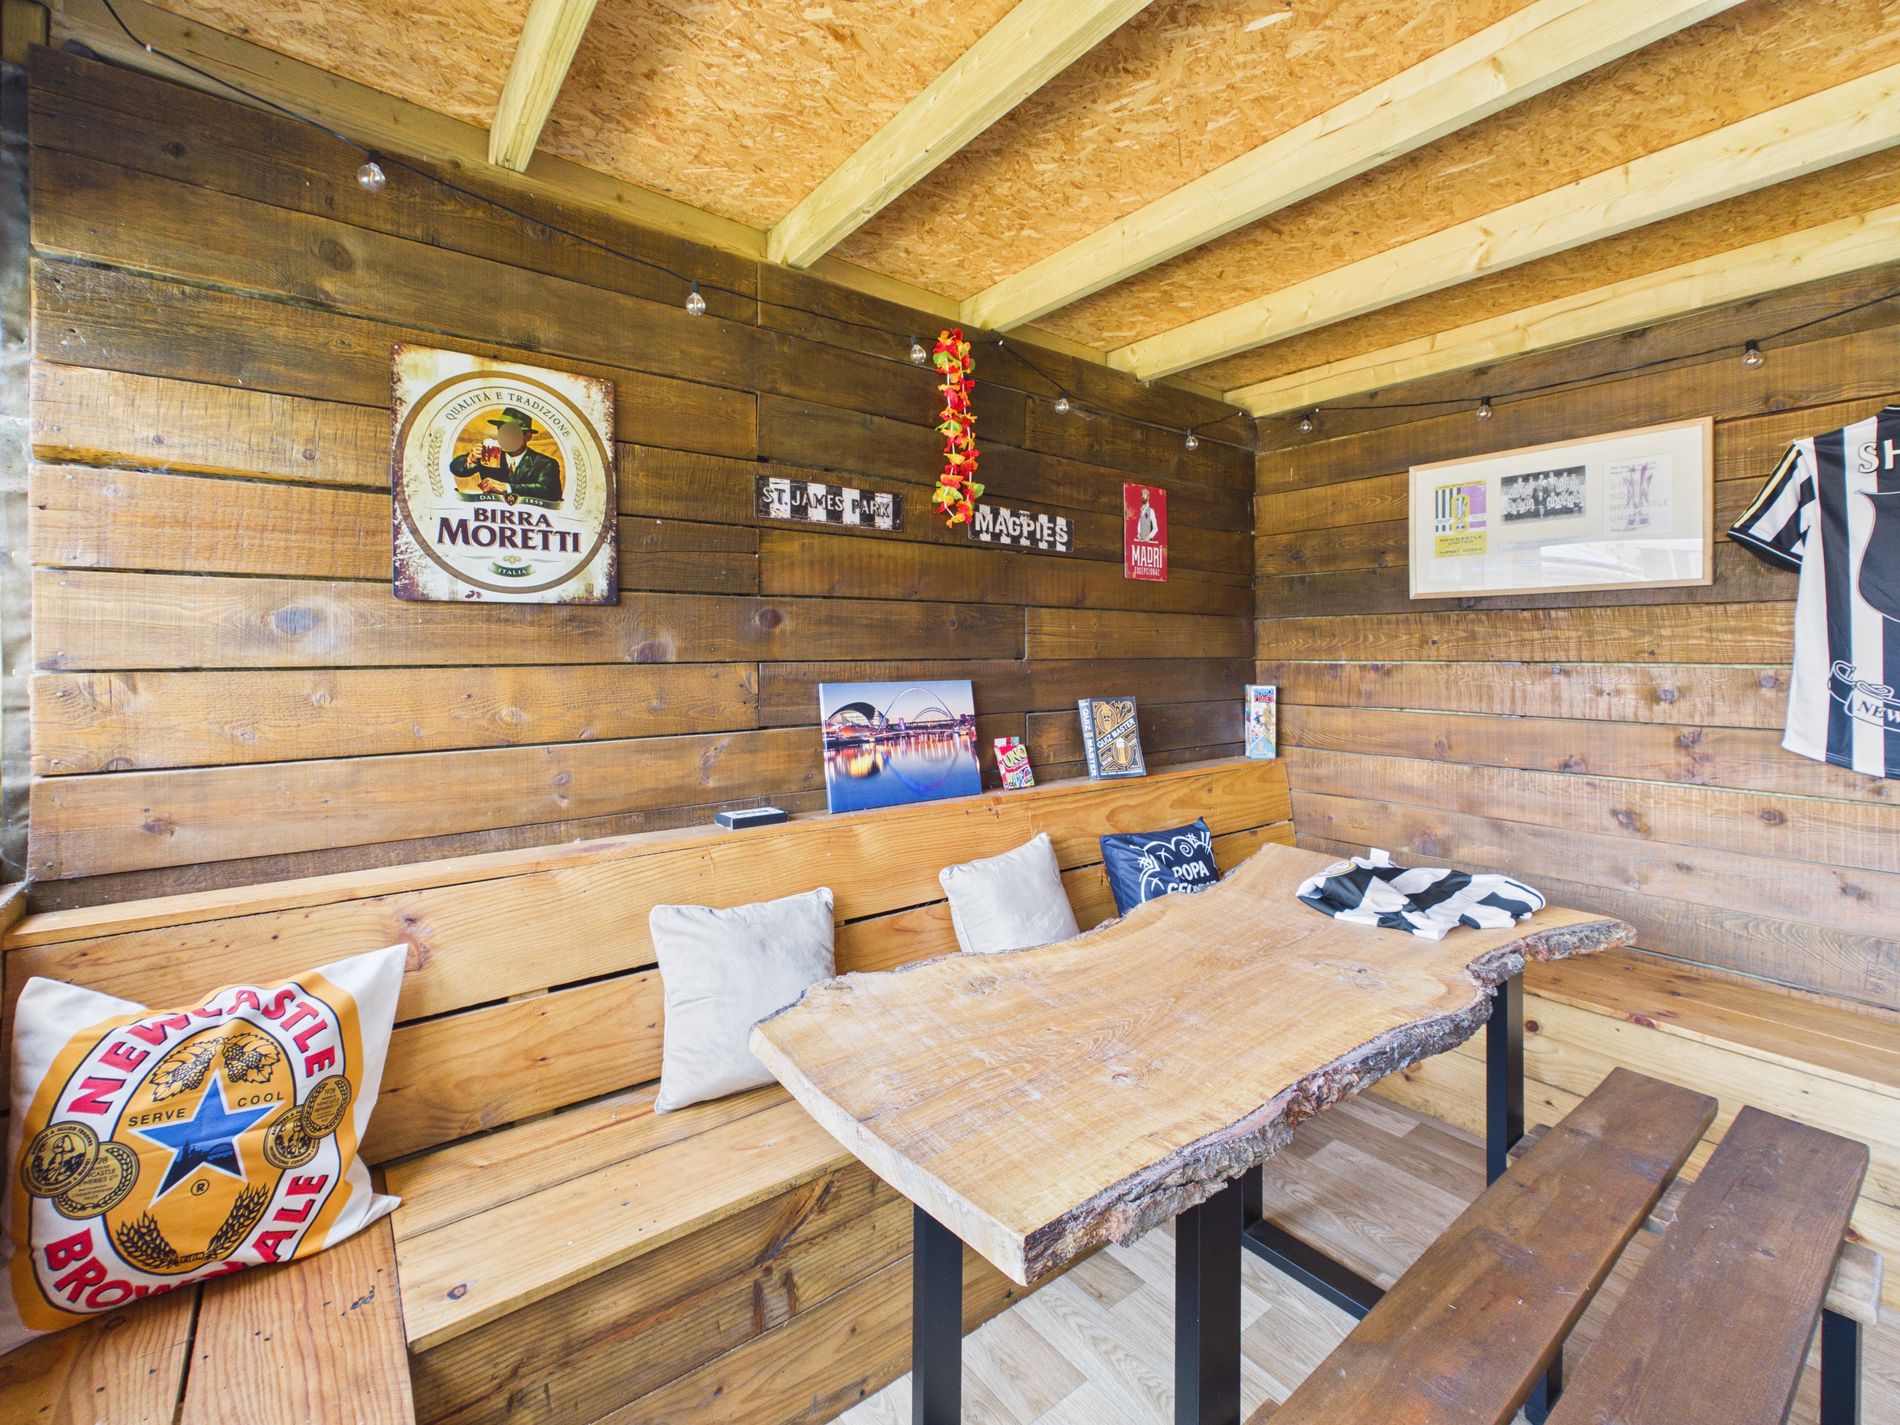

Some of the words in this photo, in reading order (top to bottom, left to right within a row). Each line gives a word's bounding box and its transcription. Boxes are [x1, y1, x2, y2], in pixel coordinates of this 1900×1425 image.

[445, 391, 491, 421] QUALITÀ
[495, 391, 503, 400] E
[507, 392, 571, 438] TRADIZIONE
[525, 498, 543, 506] 1859
[762, 486, 788, 505] ST.
[791, 490, 844, 511] JAMES
[852, 498, 890, 517] PARK
[473, 507, 554, 528] BIRRA
[975, 511, 1068, 543] MAGPIES
[437, 517, 583, 553] MORETTI
[498, 567, 527, 576] ITALIA
[1082, 708, 1091, 731] QUIZ
[1087, 741, 1097, 776] MASTER
[1096, 735, 1113, 748] QUIZ
[1112, 718, 1136, 738] MASTER
[1002, 745, 1027, 768] UNO
[128, 1107, 186, 1126] SERVE
[237, 1091, 285, 1107] COOL
[252, 1174, 329, 1264] ALE
